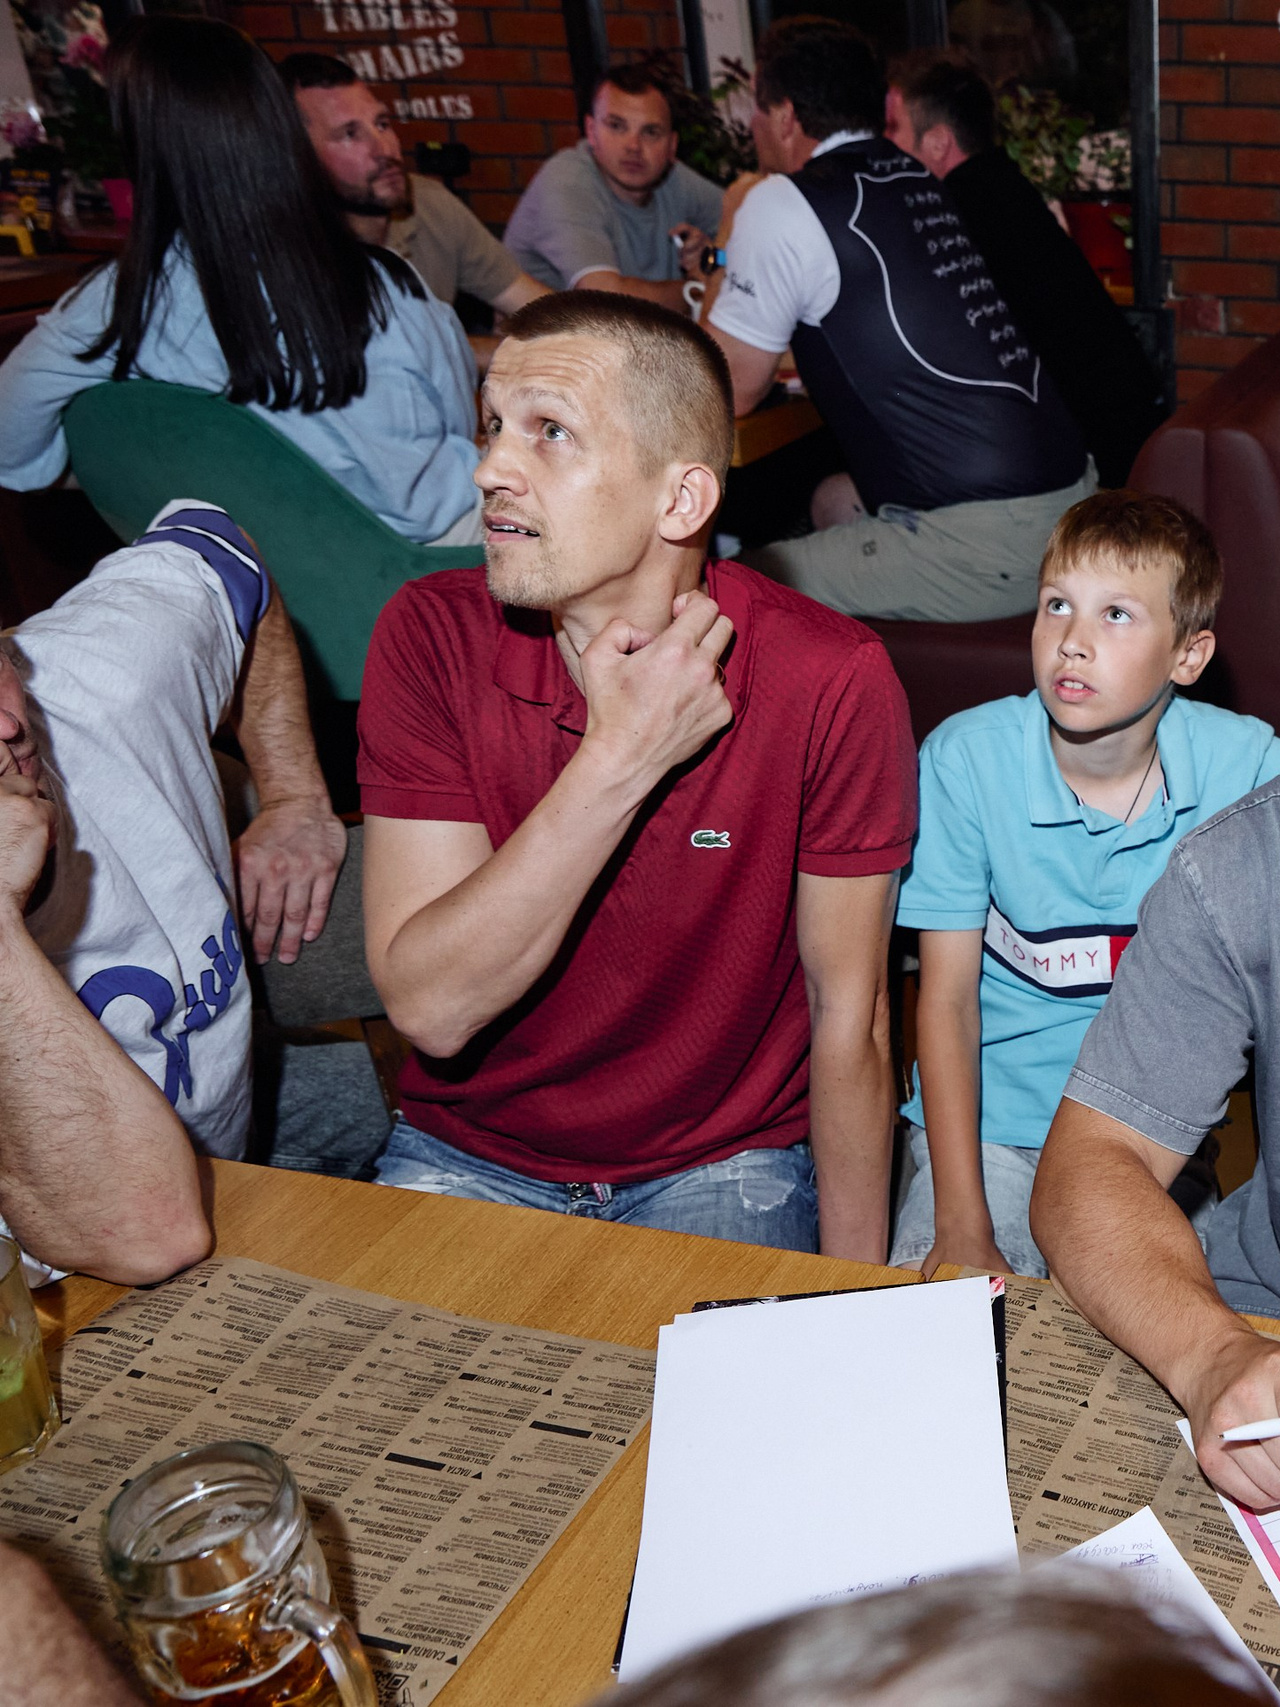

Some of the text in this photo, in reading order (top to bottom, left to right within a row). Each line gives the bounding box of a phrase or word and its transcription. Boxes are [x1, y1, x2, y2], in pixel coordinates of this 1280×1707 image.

[343, 31, 464, 80] HAIRS
[1000, 927, 1098, 973] TOMMY
[1002, 1297, 1025, 1306] СОУС
[105, 1328, 145, 1342] ГАРНИРЫ
[472, 1374, 541, 1394] ГОРЯЧИЕ ЗАКУСКИ
[1009, 1381, 1042, 1394] СКОВОРОДА
[592, 1432, 616, 1442] СУПЫ
[1156, 1439, 1179, 1449] АССОРТИ
[444, 1465, 472, 1476] ПАСТА
[1060, 1494, 1134, 1521] АССОРТИ ЗАКУСОК
[1191, 1538, 1215, 1549] СОУСОМ
[1218, 1552, 1250, 1566] КАМАМБЕР
[1193, 1565, 1243, 1584] СЫРНЫЕ ШАРИКИ
[408, 1645, 446, 1660] САЛАТЫ
